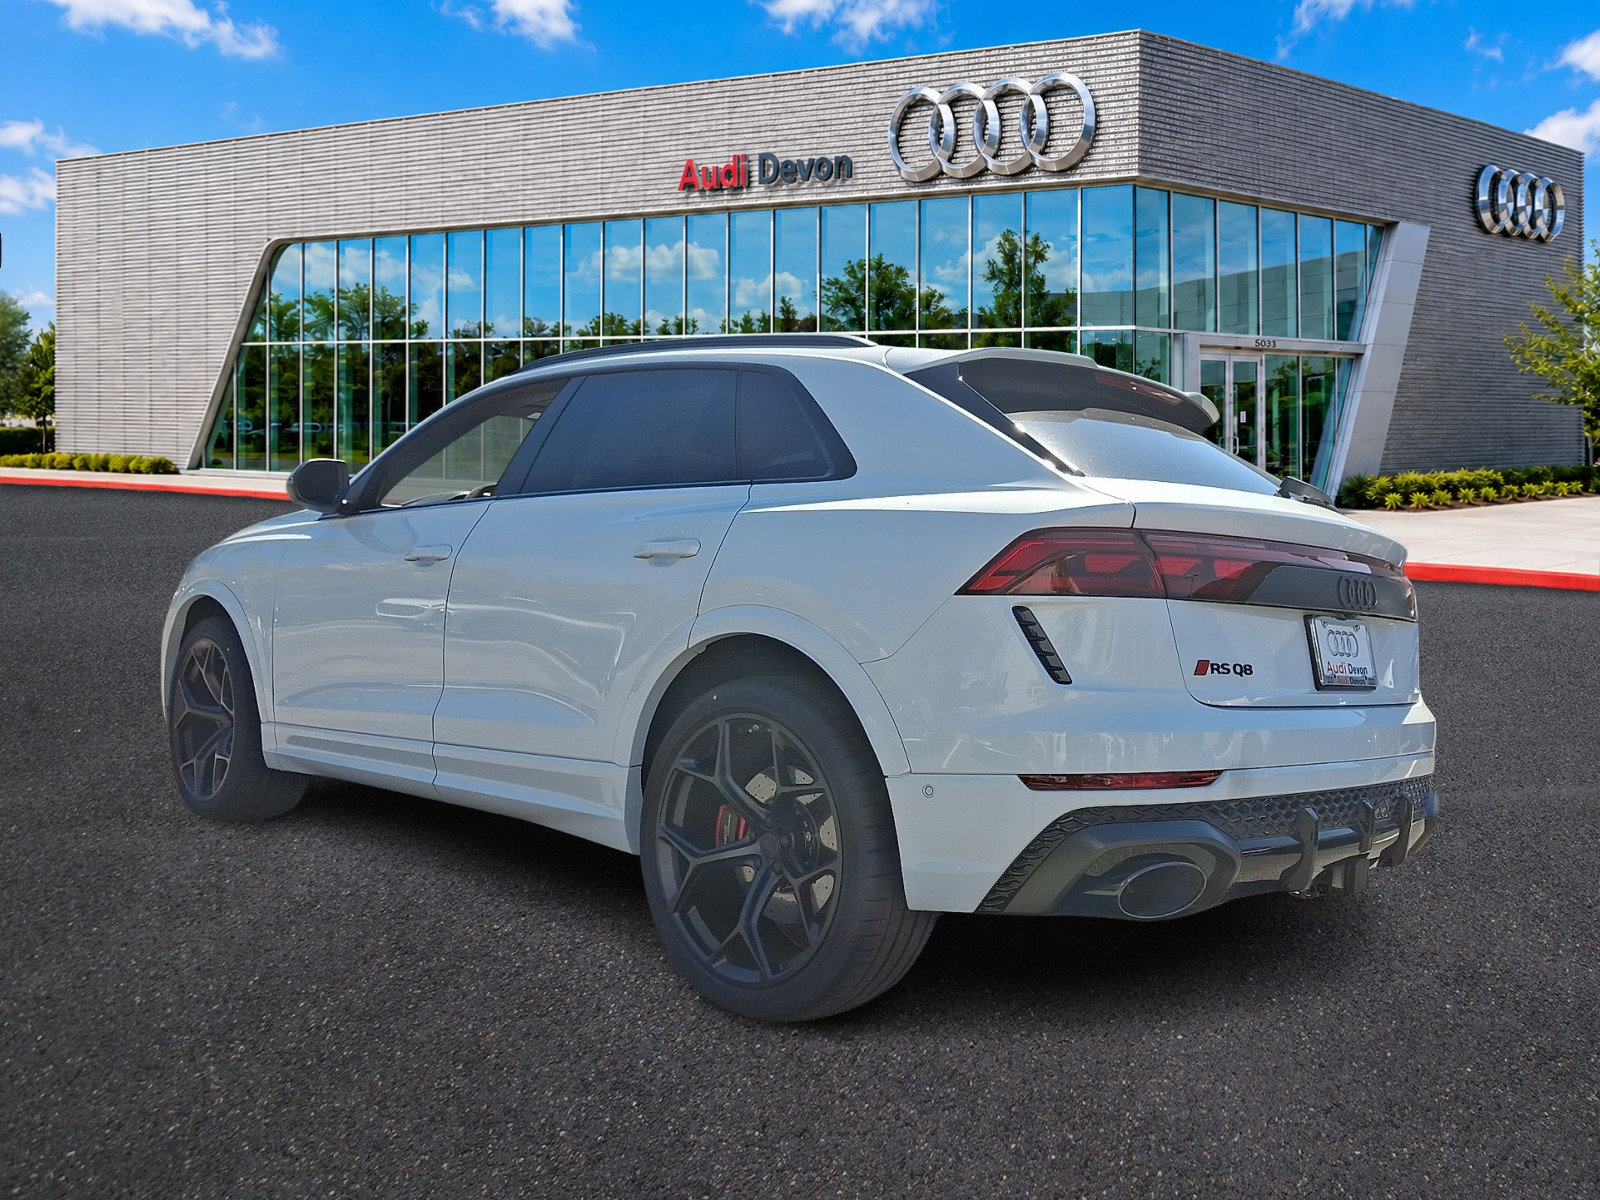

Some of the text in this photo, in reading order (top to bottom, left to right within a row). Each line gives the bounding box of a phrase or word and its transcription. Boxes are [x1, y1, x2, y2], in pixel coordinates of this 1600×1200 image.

[678, 152, 853, 191] Audi Devon
[1255, 339, 1276, 348] 5033
[1210, 663, 1253, 677] RS Q8
[1327, 661, 1368, 675] Audi Devon
[1349, 677, 1366, 685] Devon
